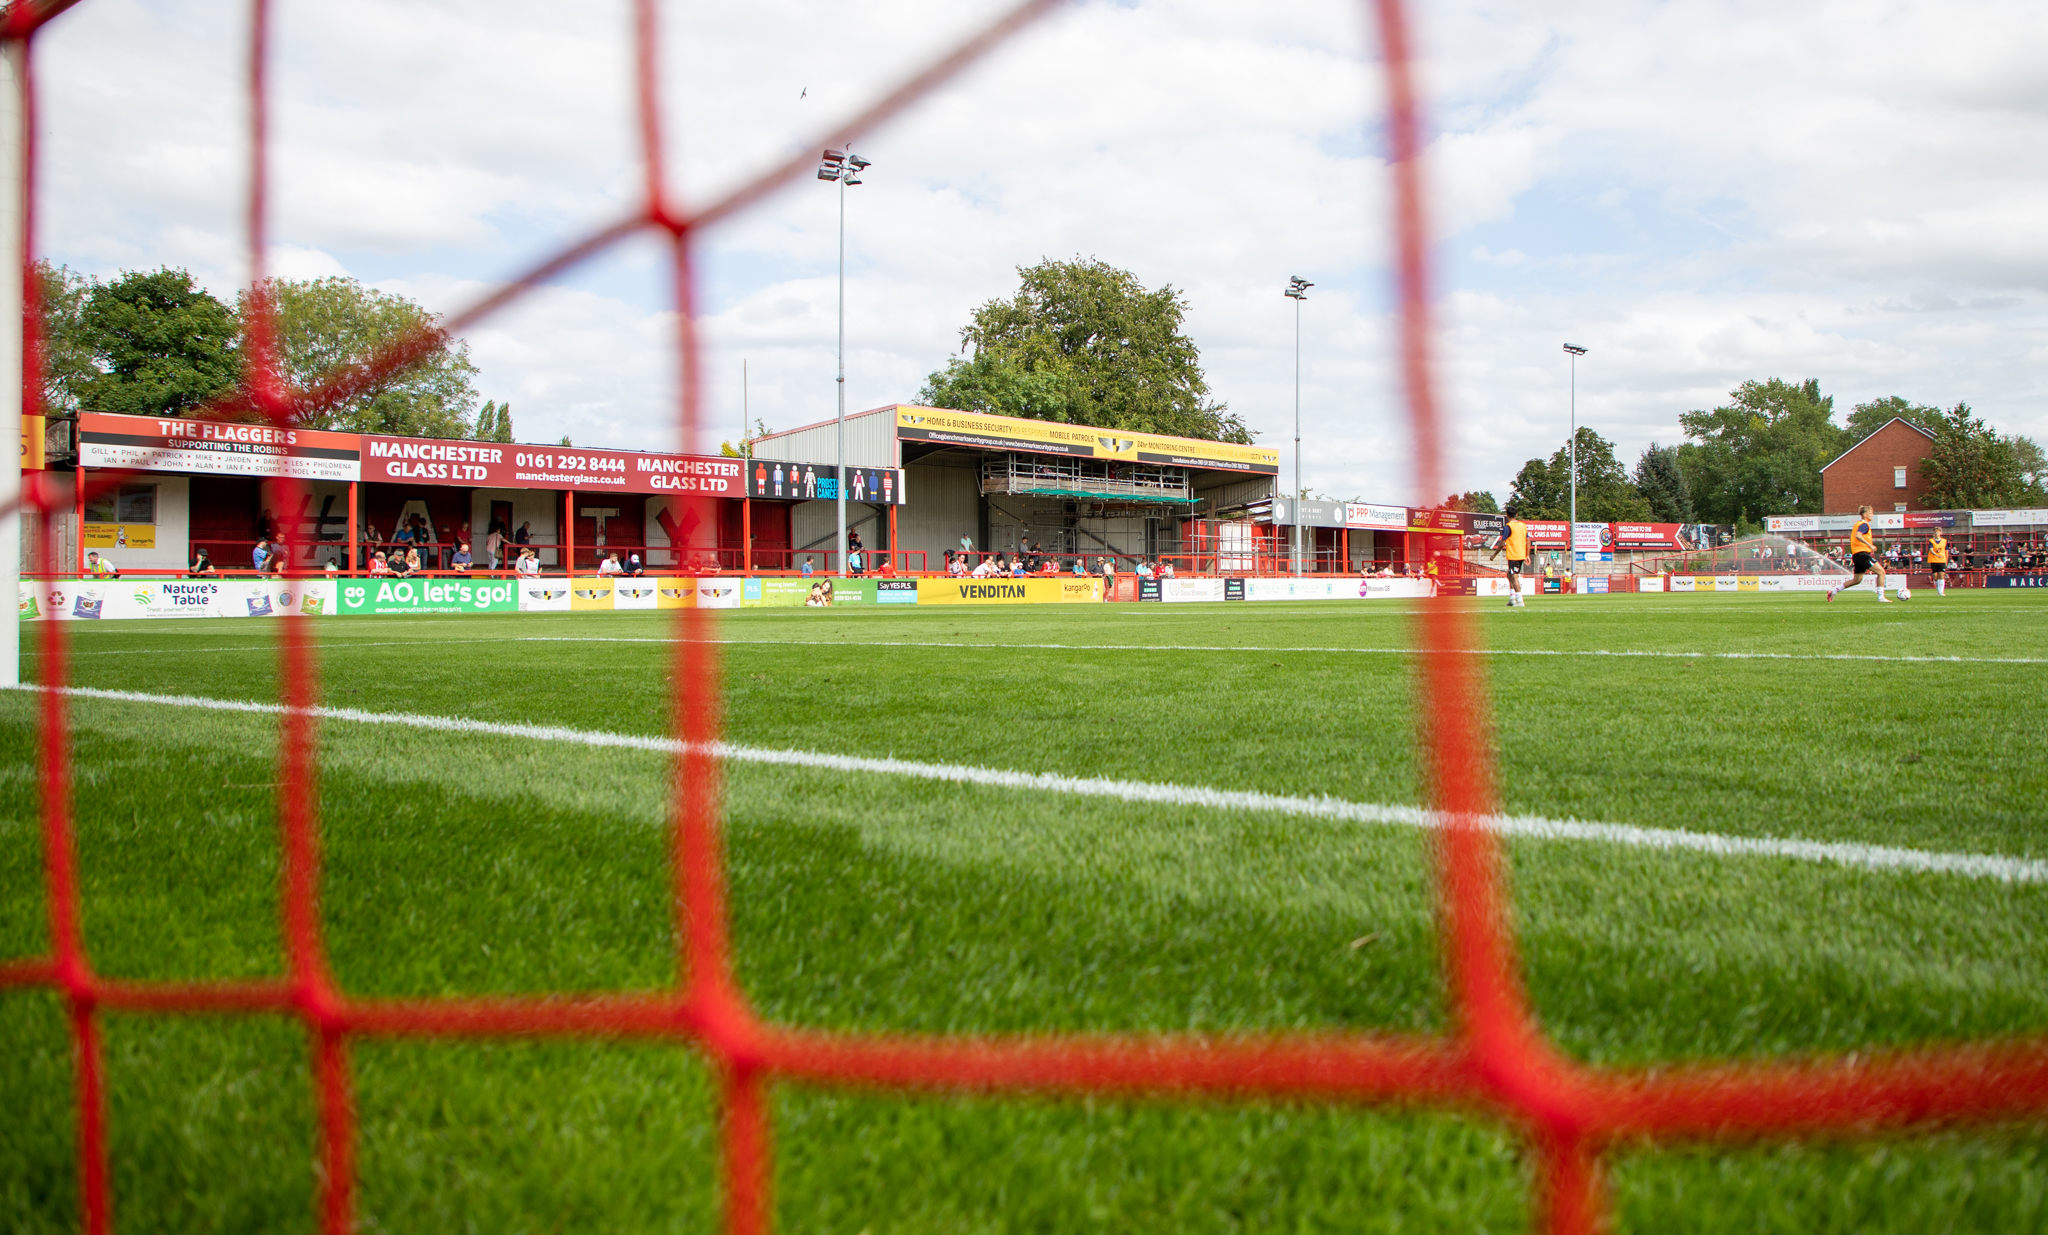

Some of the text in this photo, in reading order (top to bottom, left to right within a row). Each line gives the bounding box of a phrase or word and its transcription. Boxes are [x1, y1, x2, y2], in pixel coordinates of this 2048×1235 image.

[158, 421, 297, 444] THE FLAGGERS
[927, 417, 945, 427] HOME
[947, 419, 951, 427] &
[952, 420, 983, 430] BUSINESS
[984, 422, 1012, 434] SECURITY
[1022, 427, 1048, 437] RESPONSE
[1050, 430, 1070, 440] MOBILE
[1071, 432, 1095, 443] PATROLS
[168, 439, 288, 455] SUPPORTING THE ROBINS
[369, 441, 503, 464] MANCHESTER
[1148, 442, 1178, 451] MONITORING
[1179, 445, 1195, 453] CENTRE
[1251, 453, 1261, 461] CCTV
[92, 447, 108, 455] GILL
[121, 449, 139, 457] PHIL
[152, 451, 184, 459] PATRICK
[314, 461, 352, 470] PHILOMENA
[130, 458, 150, 466] PAUL
[515, 452, 626, 473] 0161 292 8444
[386, 461, 488, 481] GLASS LTD
[637, 458, 739, 477] MANCHESTER
[515, 472, 626, 486] manchesterglass.co.uk
[650, 475, 728, 492] GLASS LTD
[1356, 507, 1368, 518] PPP
[1369, 509, 1405, 521] Management
[1784, 519, 1814, 528] foresight
[163, 584, 218, 594] Nature's
[879, 582, 890, 590] Say
[1064, 583, 1091, 592] kangaroo
[1798, 577, 1841, 587] Fieldings
[344, 587, 365, 597] ao
[375, 581, 512, 608] AO, let's go!
[959, 585, 1026, 598] VENDITAN
[172, 595, 209, 605] Table
